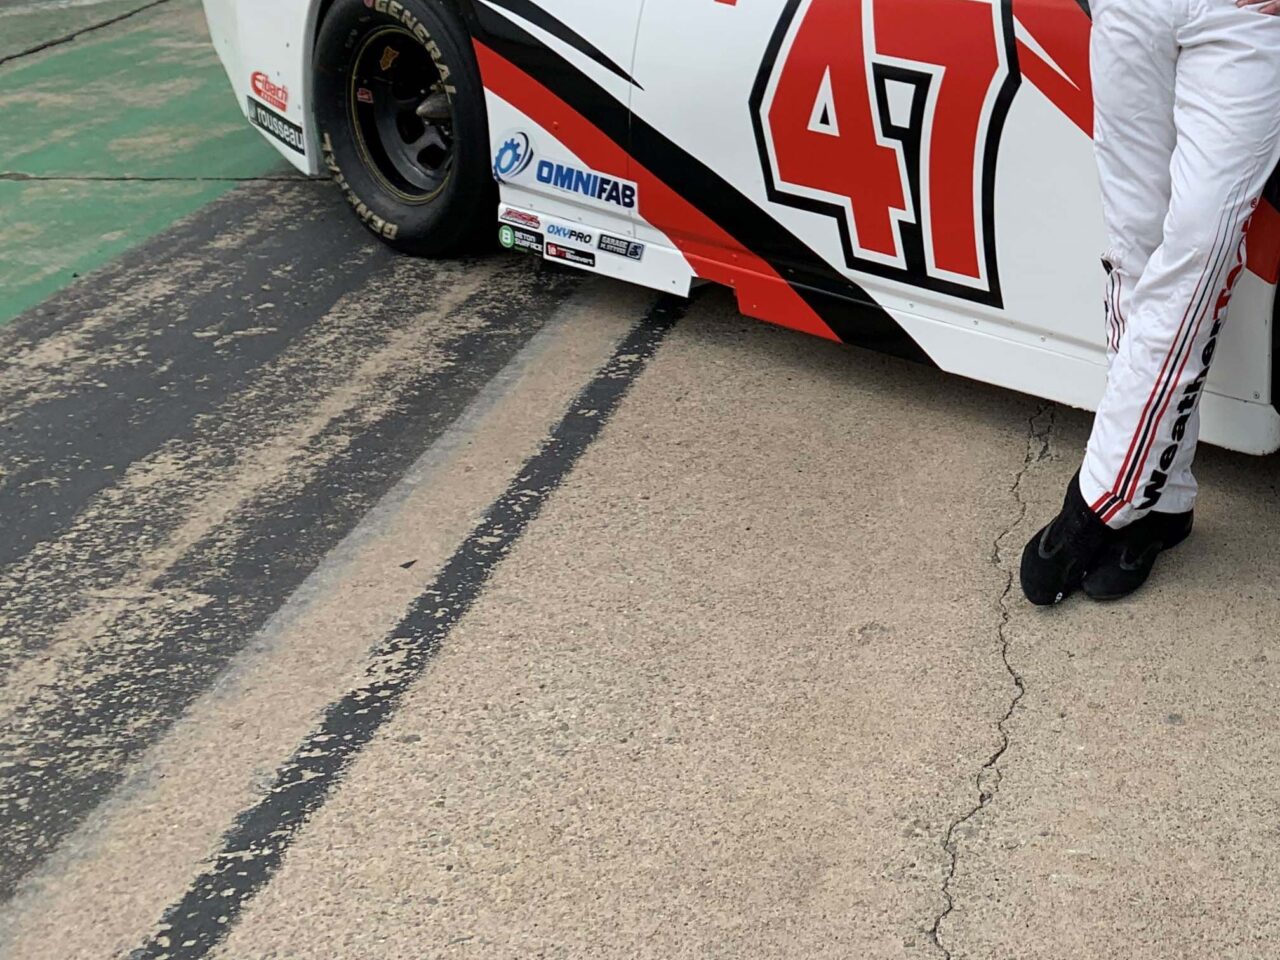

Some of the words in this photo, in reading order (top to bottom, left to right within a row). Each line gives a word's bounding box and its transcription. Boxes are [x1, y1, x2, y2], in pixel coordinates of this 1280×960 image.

[256, 106, 304, 150] rousseau
[536, 159, 635, 208] OMNIFAB
[547, 224, 592, 244] OXYPRO
